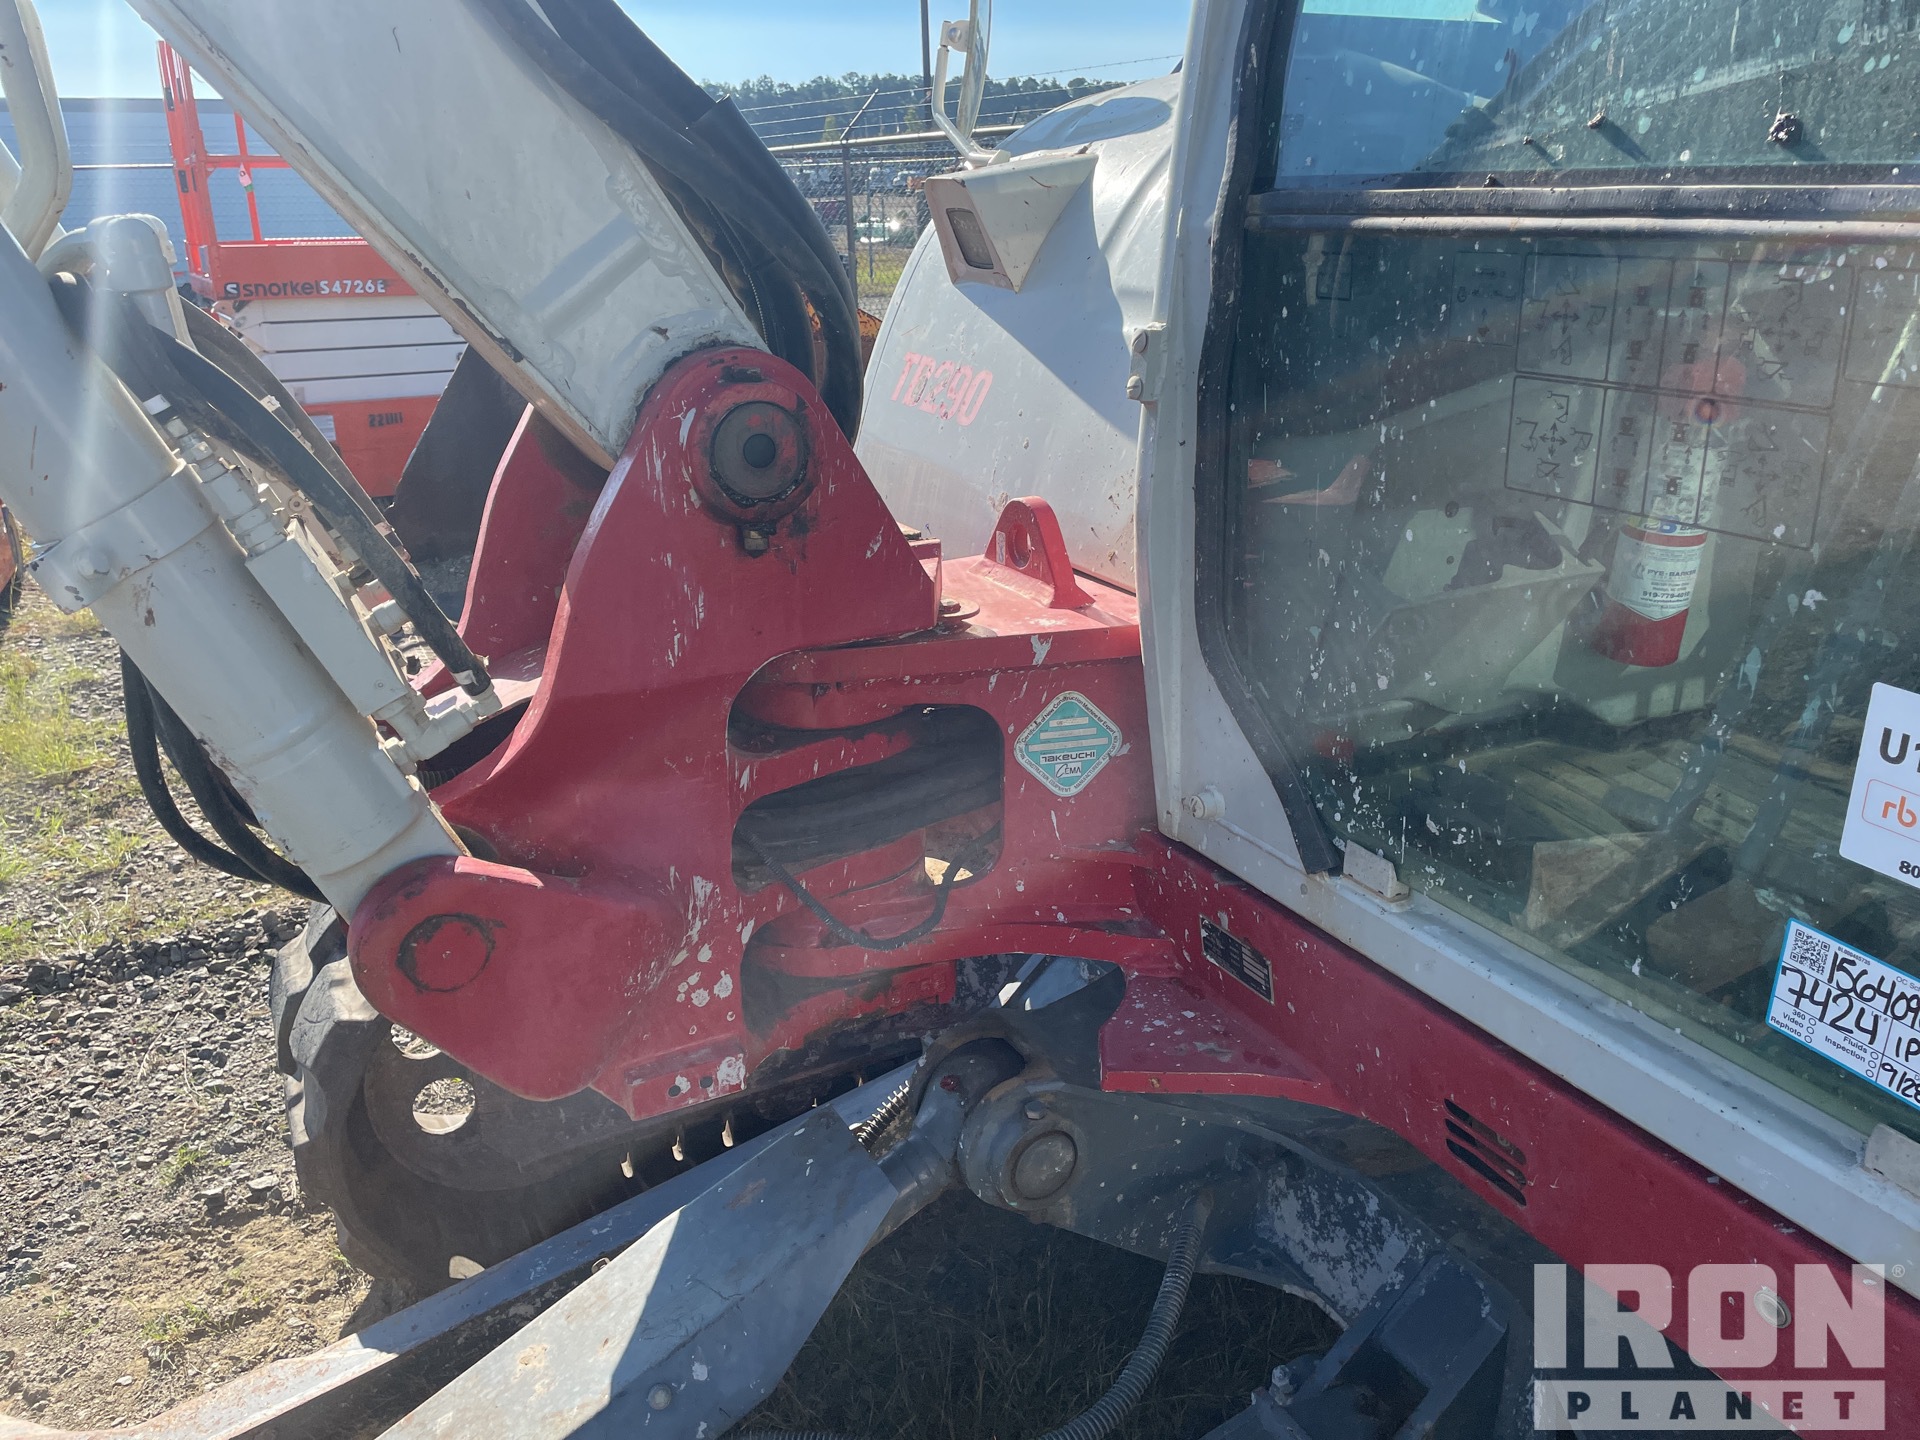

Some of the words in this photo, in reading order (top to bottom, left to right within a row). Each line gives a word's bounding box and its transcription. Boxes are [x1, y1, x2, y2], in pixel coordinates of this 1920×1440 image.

[243, 279, 320, 298] snorkel
[320, 280, 386, 295] S4726E
[1881, 795, 1917, 828] rb
[1781, 965, 1879, 1045] 7424
[1792, 1009, 1806, 1021] 360
[1770, 1015, 1802, 1038] Rephoto
[1783, 1011, 1804, 1029] Video
[1825, 1035, 1866, 1063] Inspection
[1843, 1035, 1868, 1054] Fluids
